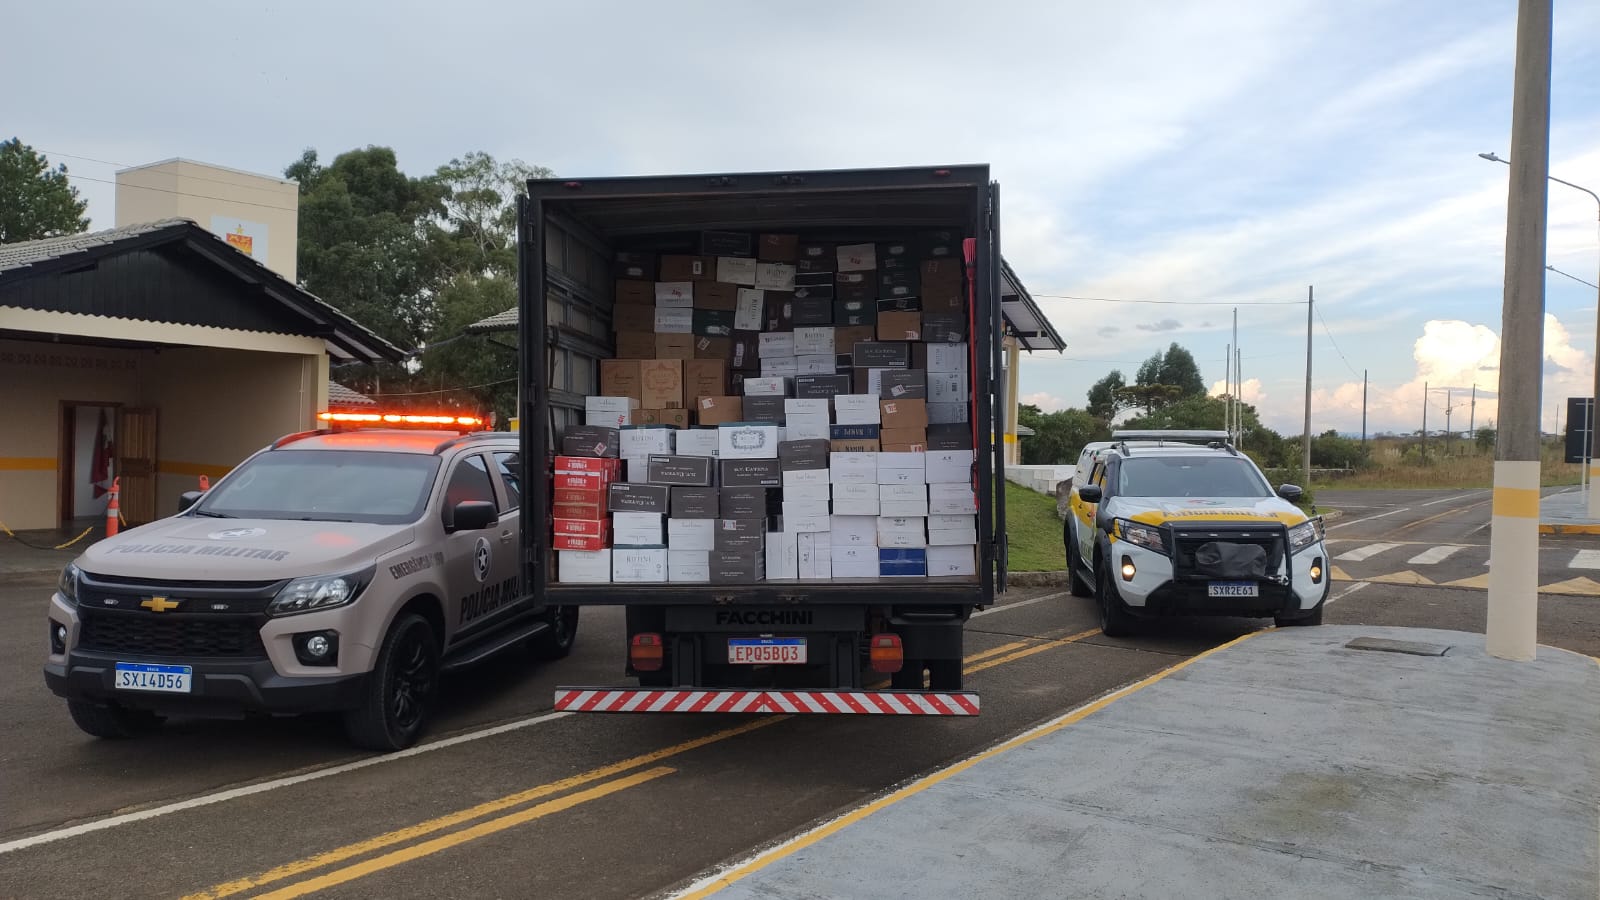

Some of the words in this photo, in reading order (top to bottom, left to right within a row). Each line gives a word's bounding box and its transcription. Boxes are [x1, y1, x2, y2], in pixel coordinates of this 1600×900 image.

[194, 545, 291, 562] MILITAR
[1213, 586, 1254, 596] SXR2E61
[460, 582, 499, 625] POLÍCIA
[716, 610, 813, 625] FACCHINI
[122, 671, 183, 689] SXI4D56
